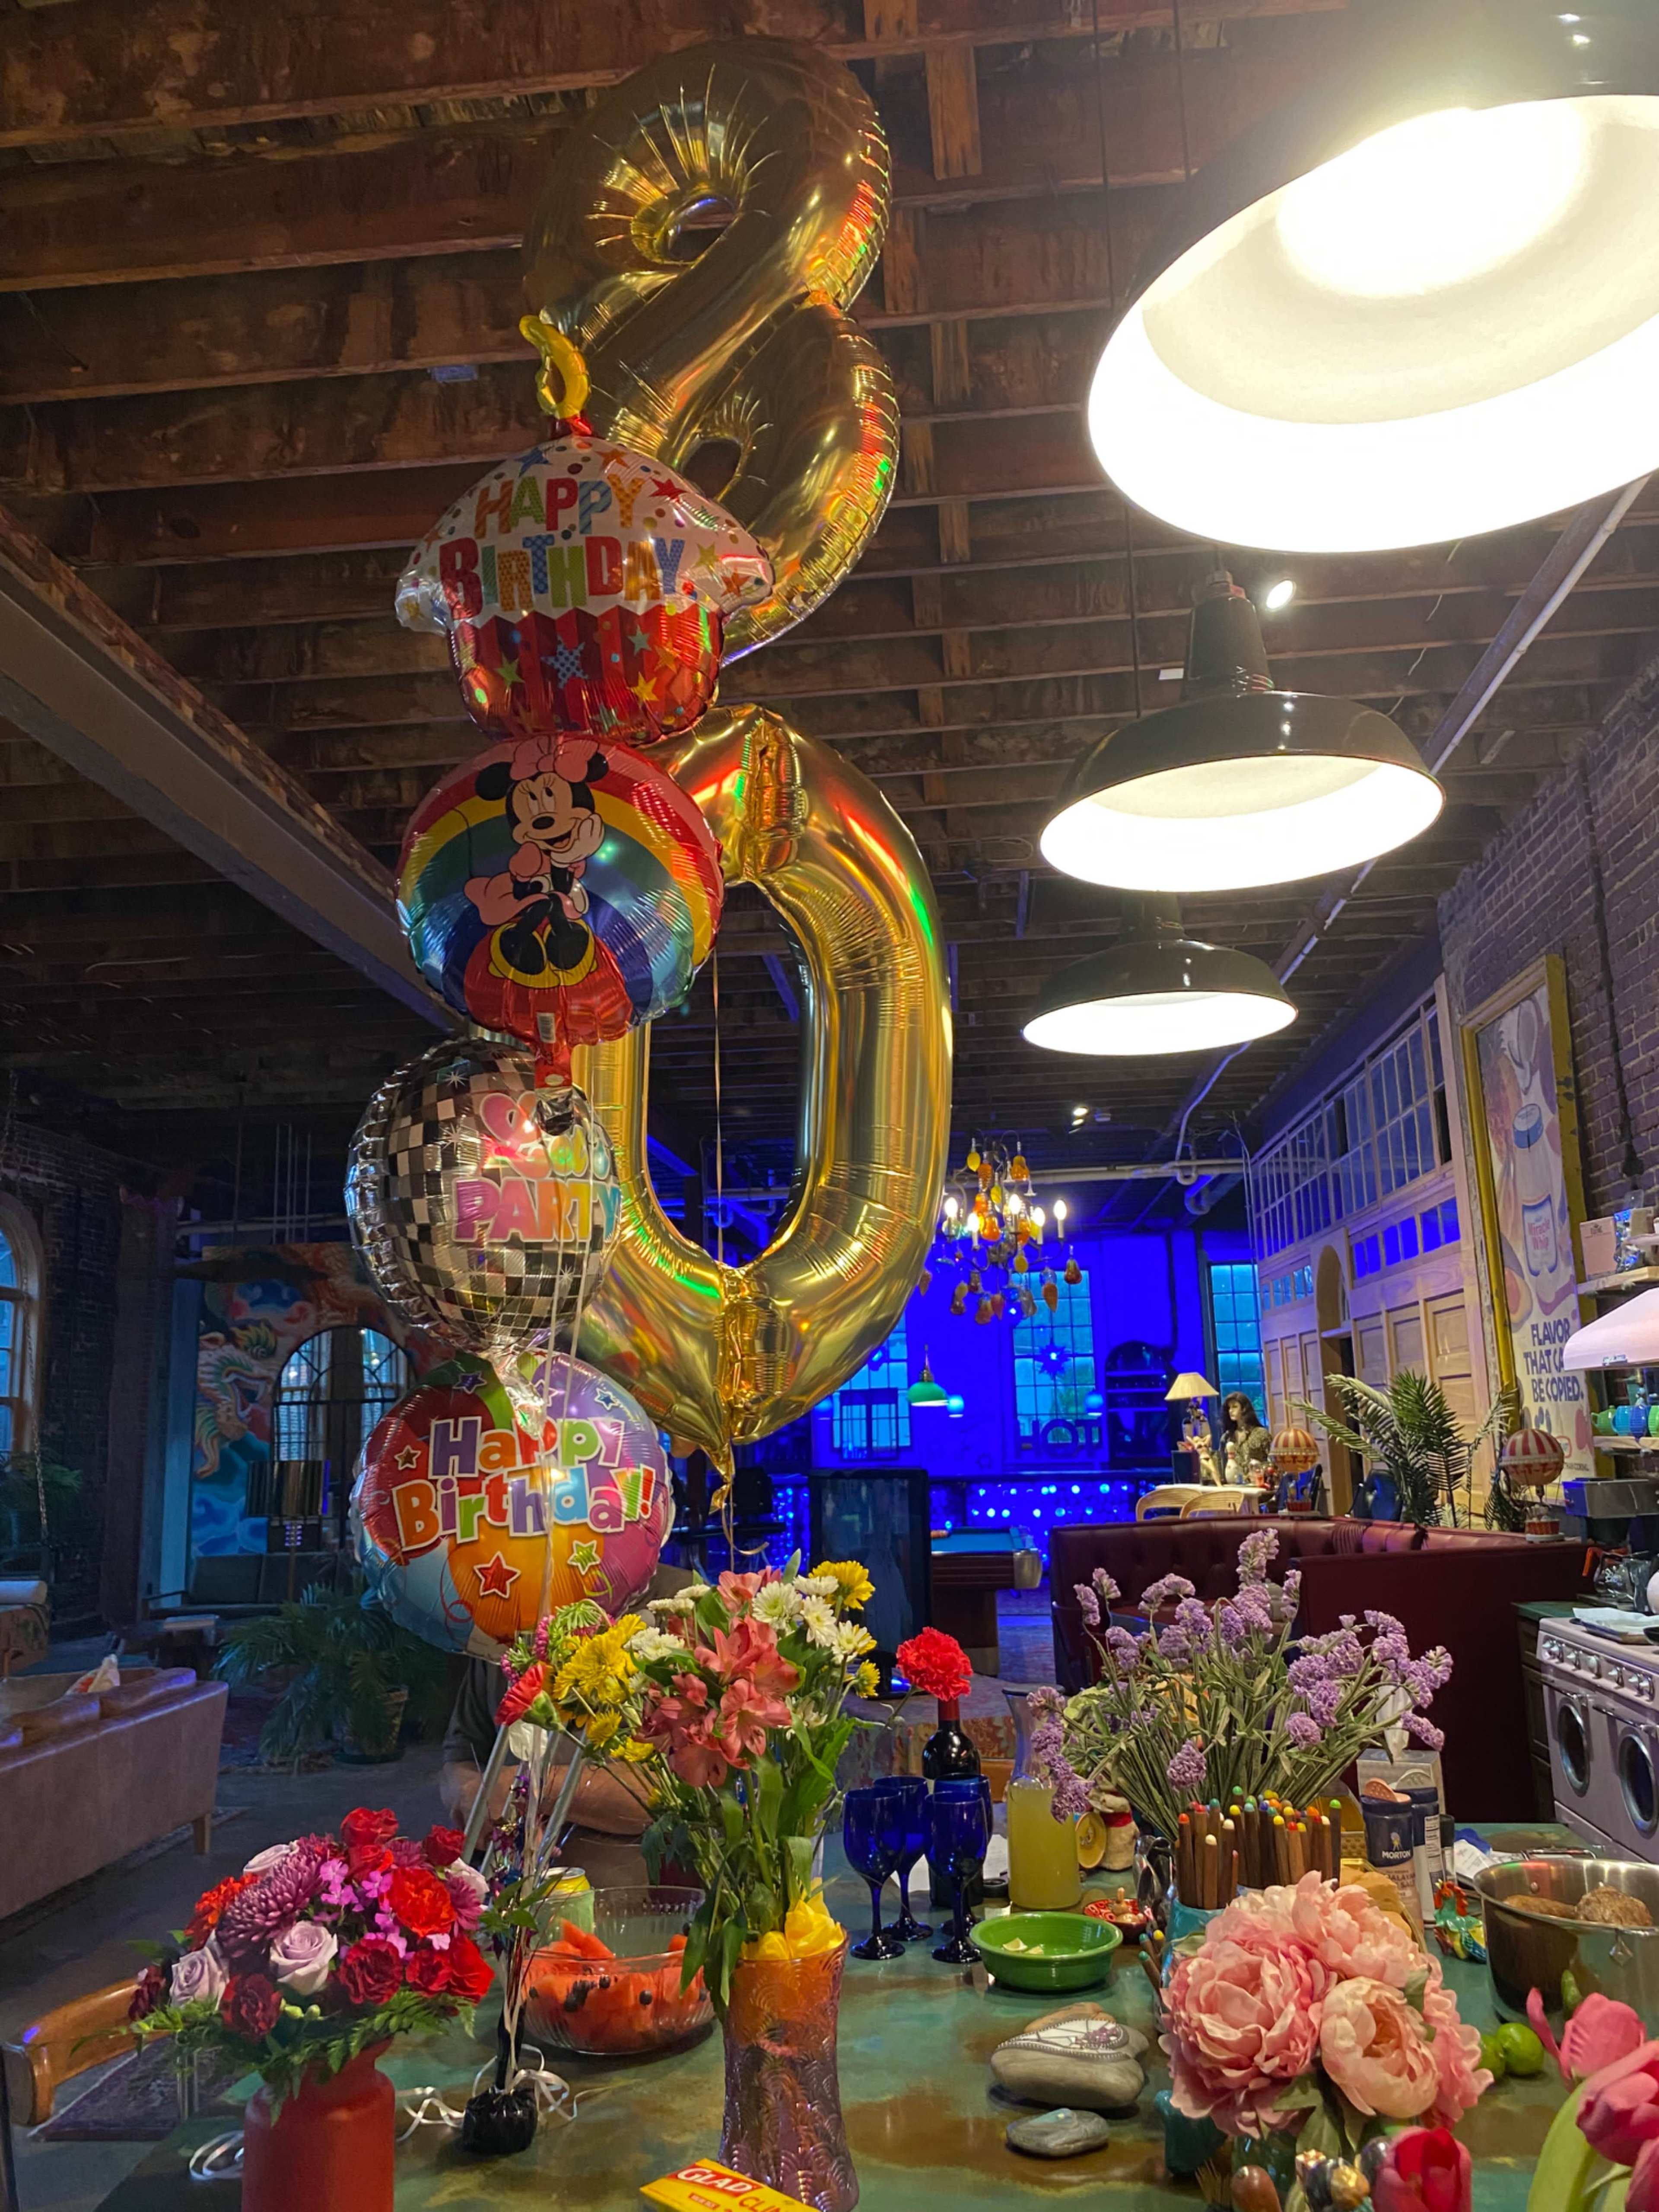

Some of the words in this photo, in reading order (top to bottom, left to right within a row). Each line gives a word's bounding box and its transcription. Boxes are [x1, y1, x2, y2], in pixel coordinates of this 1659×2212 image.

[474, 474, 645, 539] HAPPY
[439, 534, 686, 619] BIRTHDAY
[452, 1176, 622, 1244] PARTY
[1531, 1318, 1570, 1347] FLAVOR
[1523, 1349, 1551, 1375] THAT
[1531, 1378, 1545, 1403] BE
[1546, 1376, 1584, 1402] COPIED.
[429, 1416, 625, 1480] Happy
[393, 1463, 655, 1552] Birthday!
[1382, 1850, 1411, 1859] MORTON
[677, 2168, 753, 2192] GLAD
[739, 2196, 782, 2212] CLI
